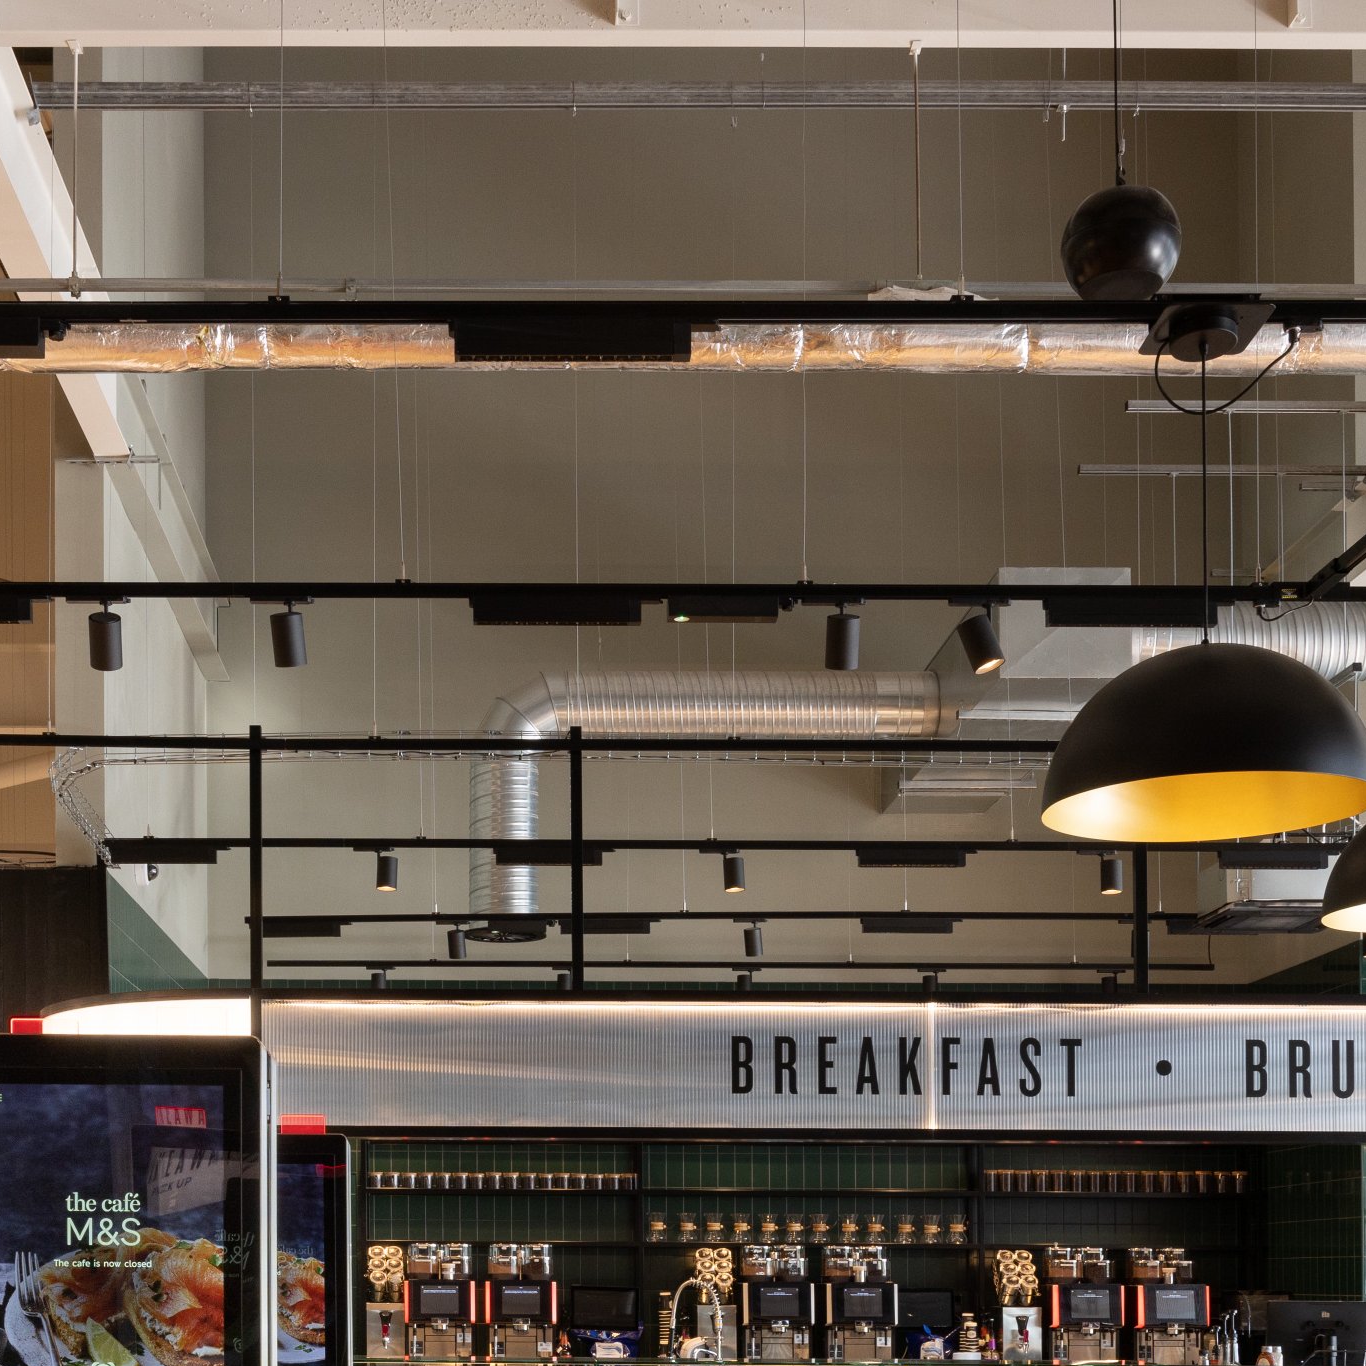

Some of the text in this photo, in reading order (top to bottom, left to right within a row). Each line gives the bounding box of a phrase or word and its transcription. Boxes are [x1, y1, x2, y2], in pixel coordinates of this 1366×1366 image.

[732, 1034, 1083, 1098] BREAKFAST
[65, 1191, 141, 1212] the café
[66, 1217, 141, 1247] M&S
[54, 1259, 70, 1267] The
[72, 1259, 91, 1268] cafe
[93, 1259, 100, 1268] is
[124, 1260, 152, 1268] closed
